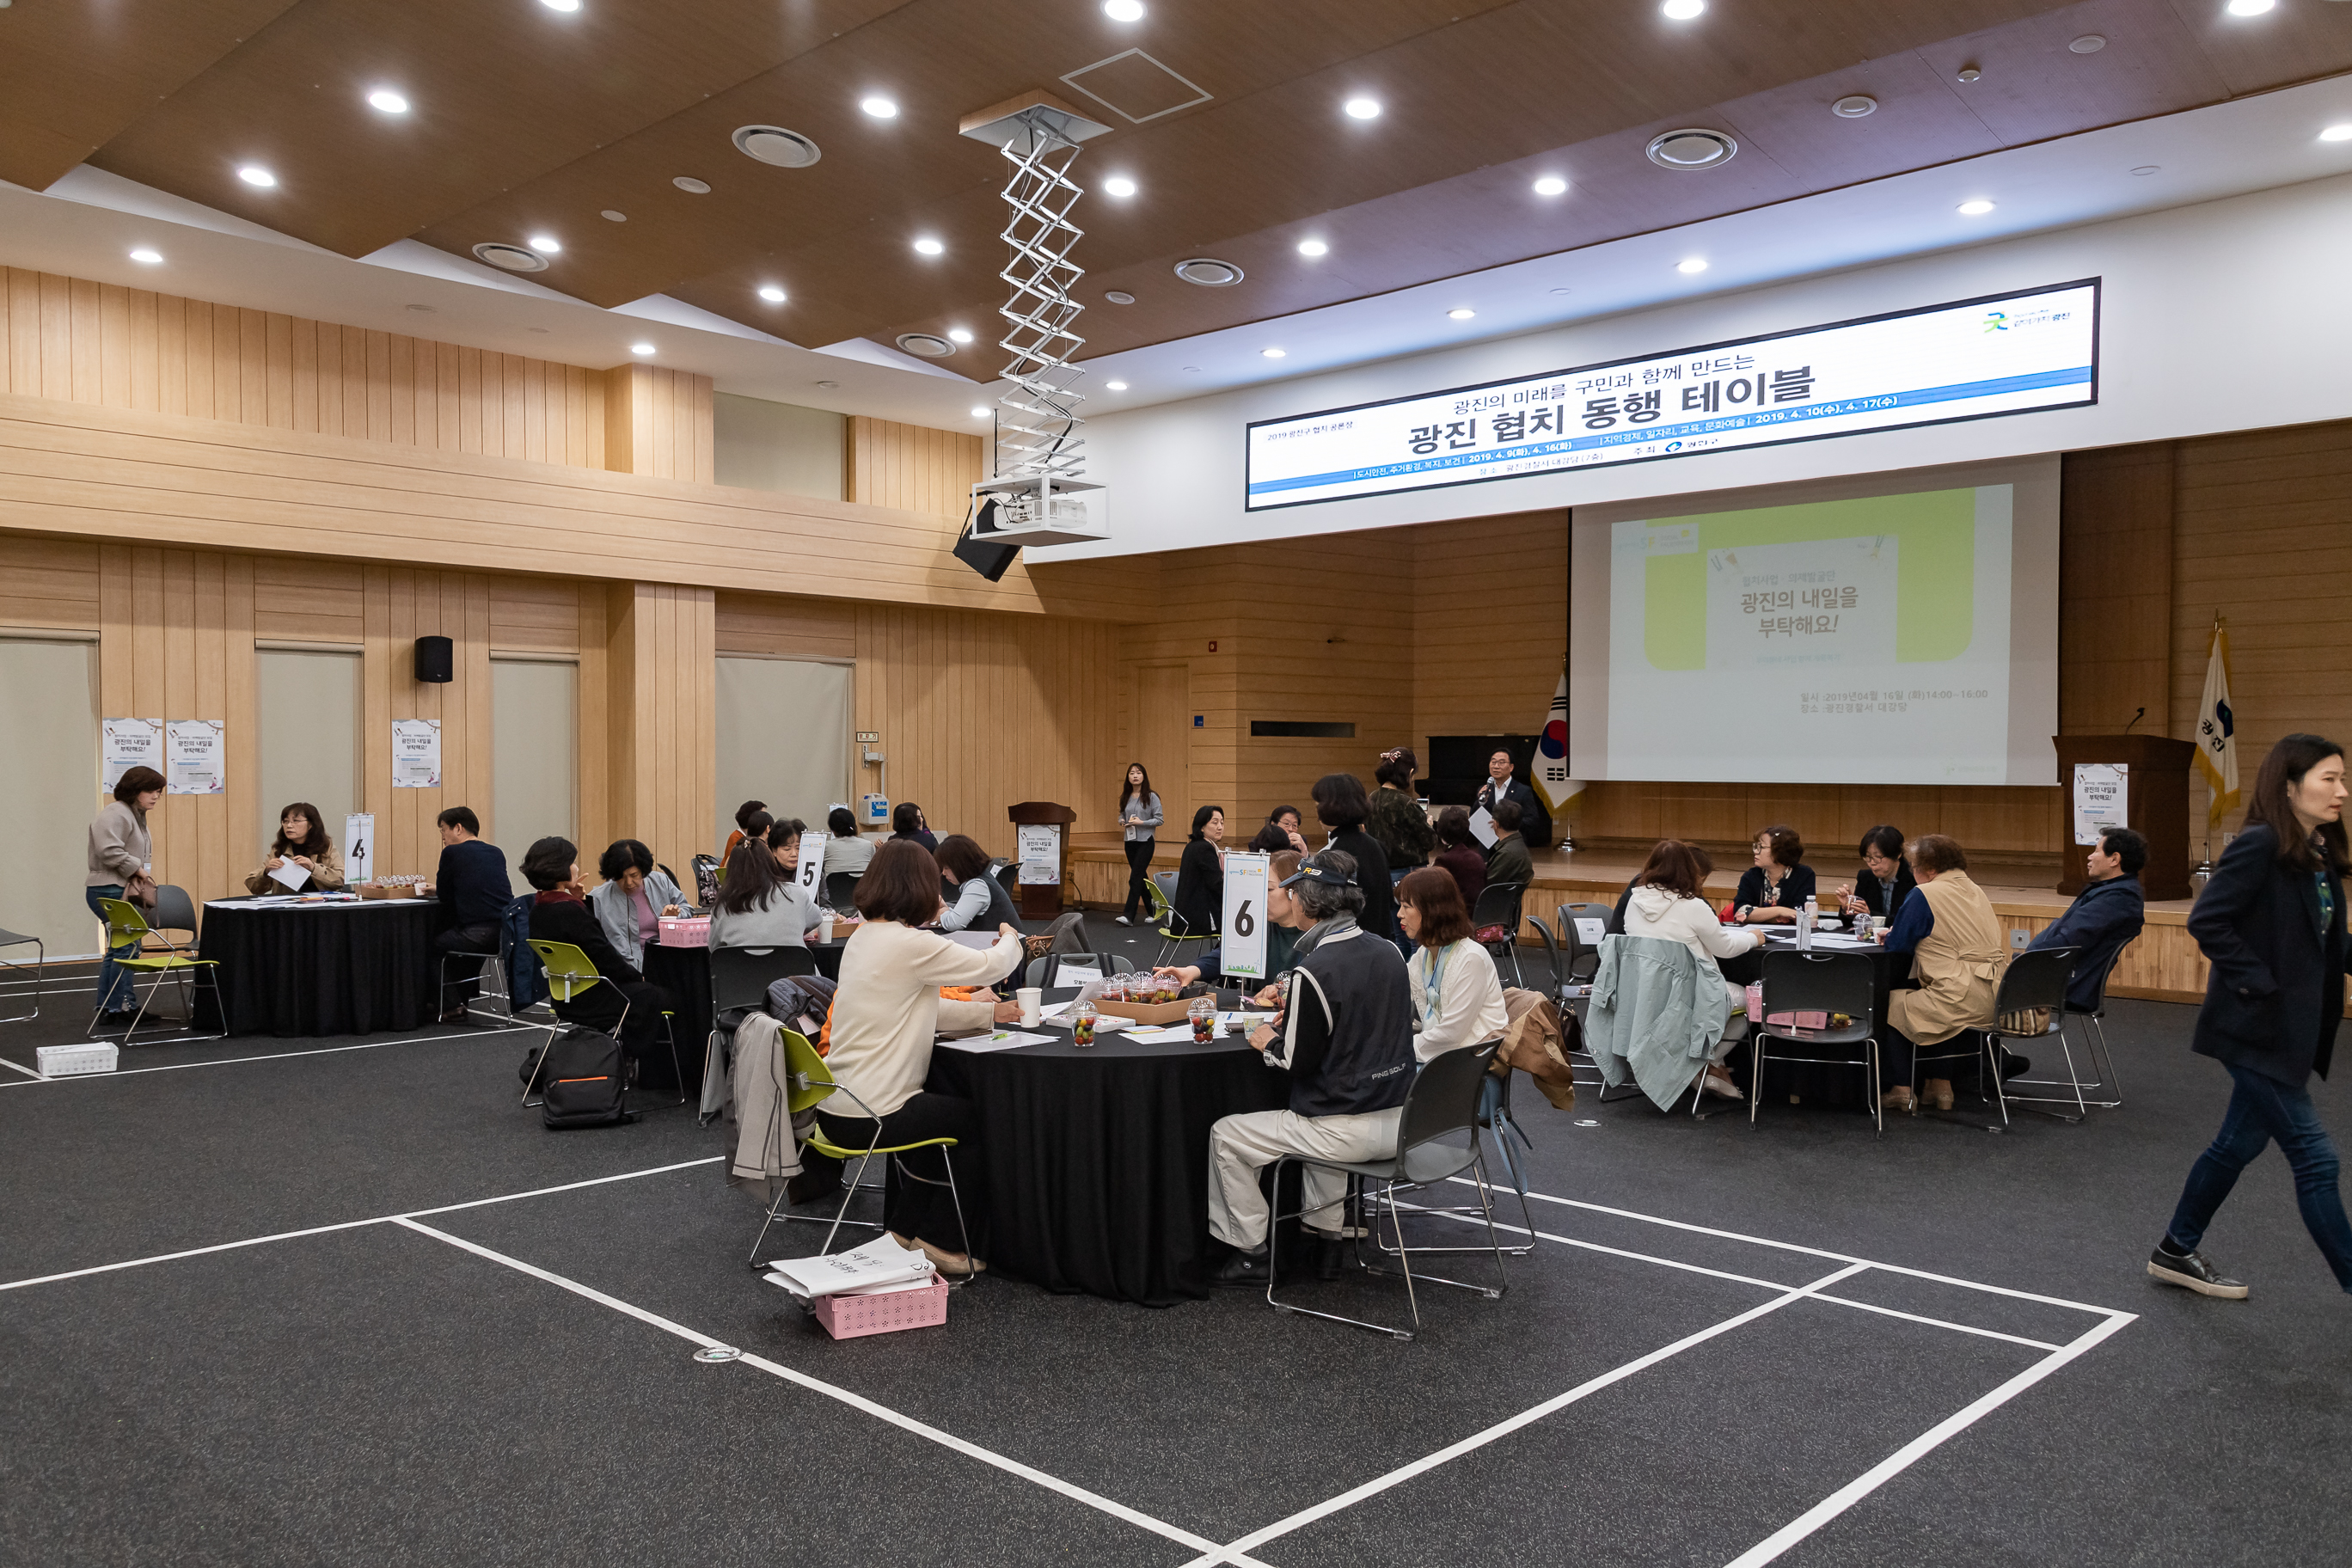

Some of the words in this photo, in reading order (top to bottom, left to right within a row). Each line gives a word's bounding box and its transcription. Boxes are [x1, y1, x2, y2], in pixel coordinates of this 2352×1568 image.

[1454, 394, 1504, 415] 광진의
[1514, 383, 1567, 404] 미래를
[1575, 372, 1633, 395] 구민과
[1642, 364, 1681, 384] 함께
[1691, 354, 1755, 377] 만드는
[1408, 418, 1477, 455] 광진
[1491, 404, 1564, 443] 협치
[1582, 389, 1661, 430] 동행
[1681, 365, 1816, 413] 테이블
[1646, 427, 1678, 440] 일자리,
[1680, 425, 1703, 435] 교육,
[1755, 412, 1788, 424] 2019.
[1790, 410, 1802, 419] 4.
[1806, 404, 1843, 417] 10(수),
[1846, 401, 1858, 411] 4.
[1862, 395, 1898, 408] 17(수)
[1267, 432, 1287, 441] 2019
[1468, 452, 1494, 463] 2019.
[1495, 451, 1504, 460] 4.
[1506, 447, 1531, 457] 9(화),
[1532, 446, 1542, 455] 4.
[1545, 441, 1572, 453] 16(화)
[1740, 590, 1794, 615] 광진의
[1801, 585, 1859, 609] 내일을
[1758, 614, 1840, 639] 부탁해요!
[1800, 693, 1819, 702] 일시
[1883, 690, 1903, 701] 16일
[1800, 704, 1819, 714] 장소
[1877, 702, 1908, 713] 대강당
[352, 839, 365, 860] 4
[803, 861, 816, 887] 5
[1234, 899, 1254, 937] 6
[1371, 1069, 1389, 1081] PING
[1388, 1063, 1406, 1075] GOLF
